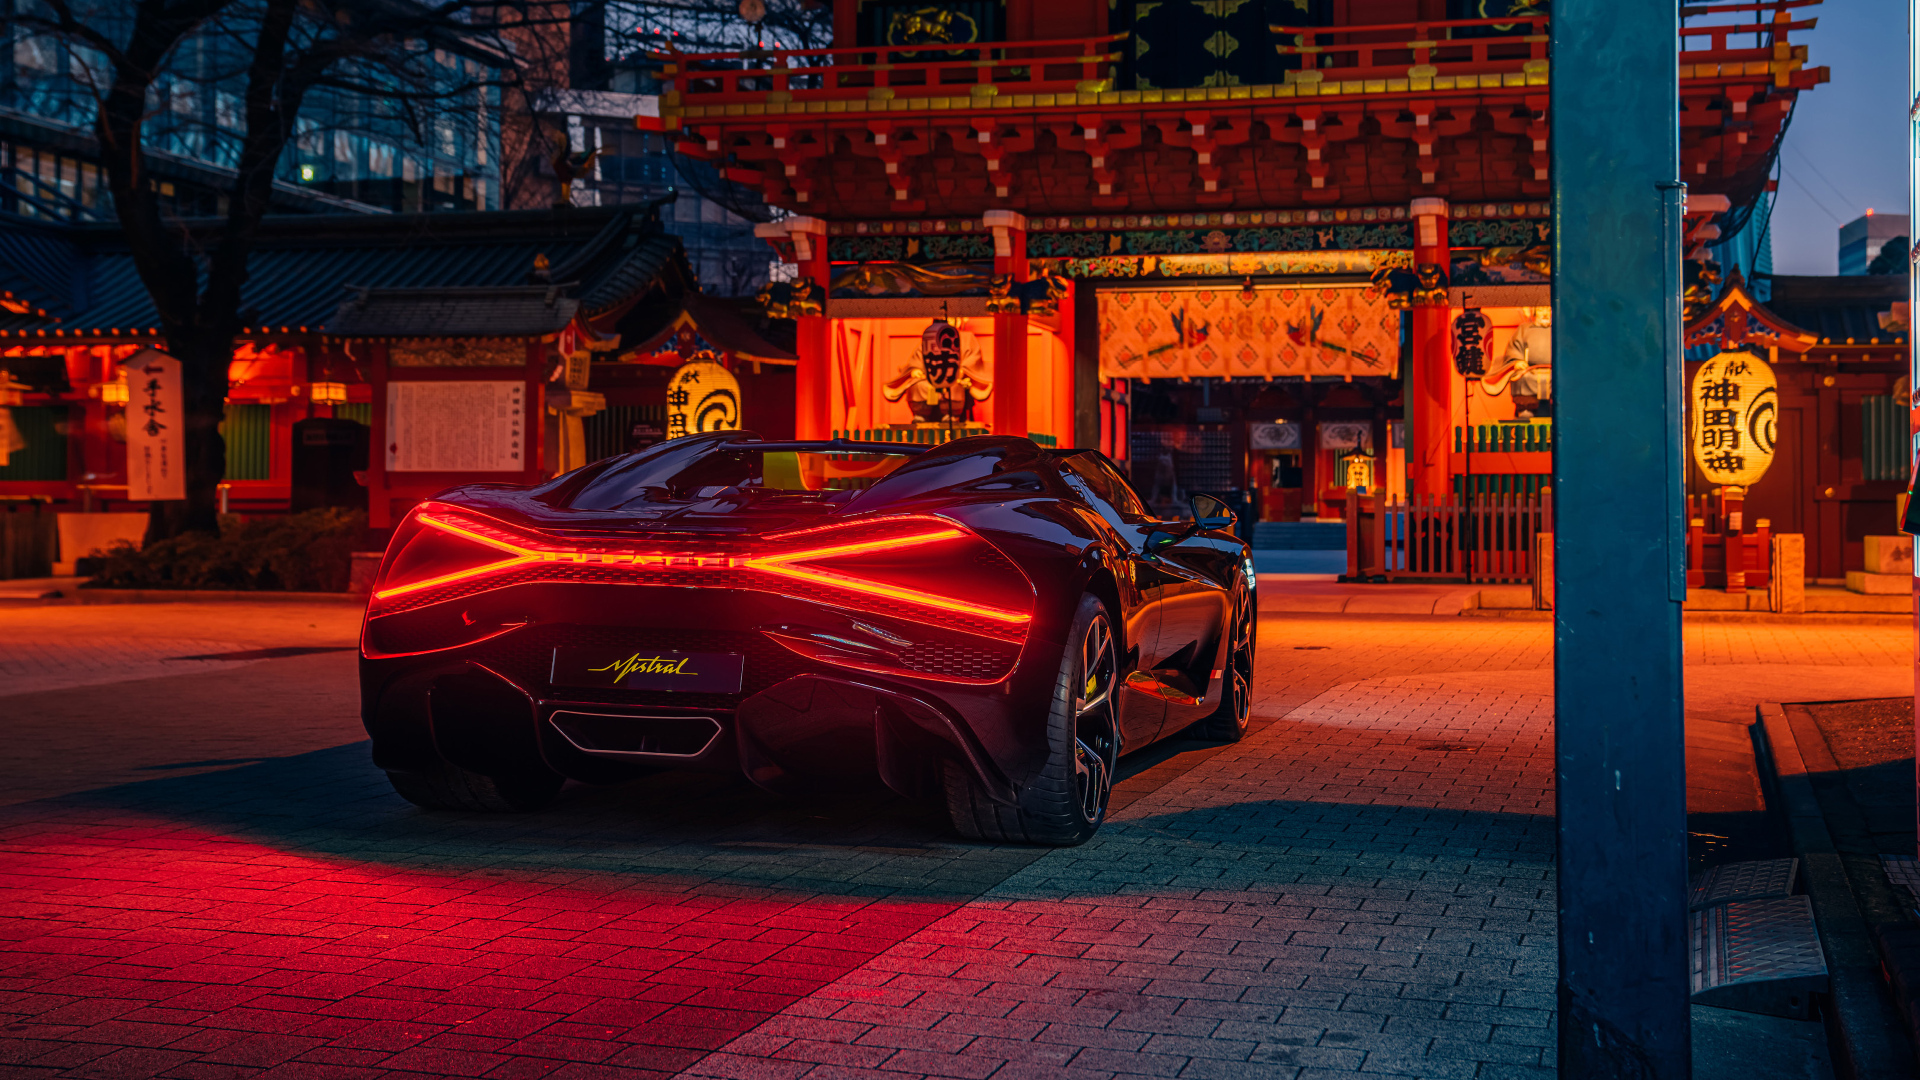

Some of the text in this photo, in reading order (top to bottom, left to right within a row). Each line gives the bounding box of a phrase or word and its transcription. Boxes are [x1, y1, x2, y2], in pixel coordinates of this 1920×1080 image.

[1700, 378, 1745, 473] 神田明神
[588, 653, 698, 683] Mistral
